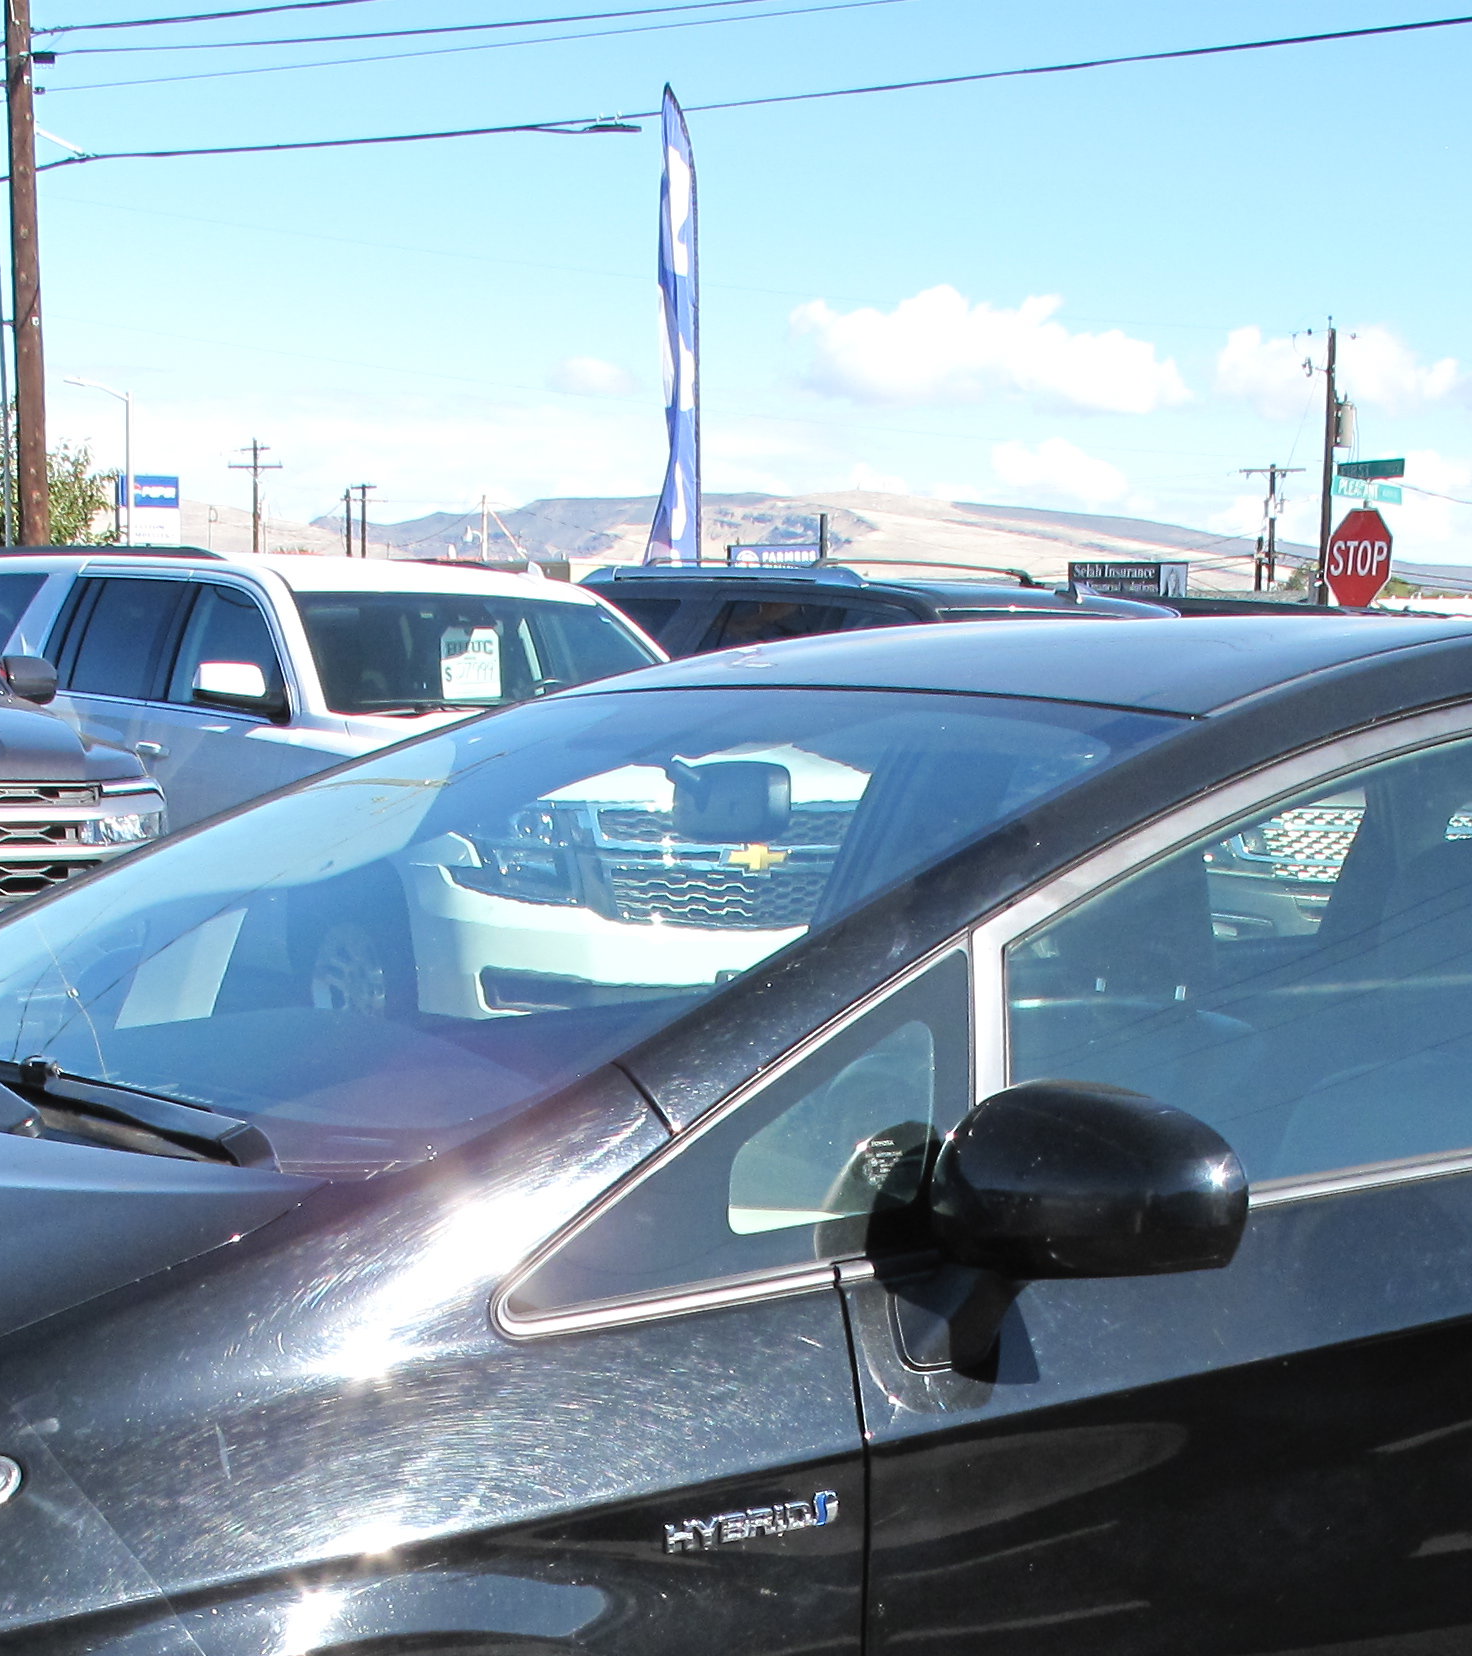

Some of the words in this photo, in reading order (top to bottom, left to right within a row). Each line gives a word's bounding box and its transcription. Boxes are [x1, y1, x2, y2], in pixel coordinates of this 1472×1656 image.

[1073, 563, 1102, 578] Selah
[1104, 563, 1156, 579] Insurance
[1330, 540, 1388, 577] STOP
[663, 1500, 813, 1554] HYBRID
